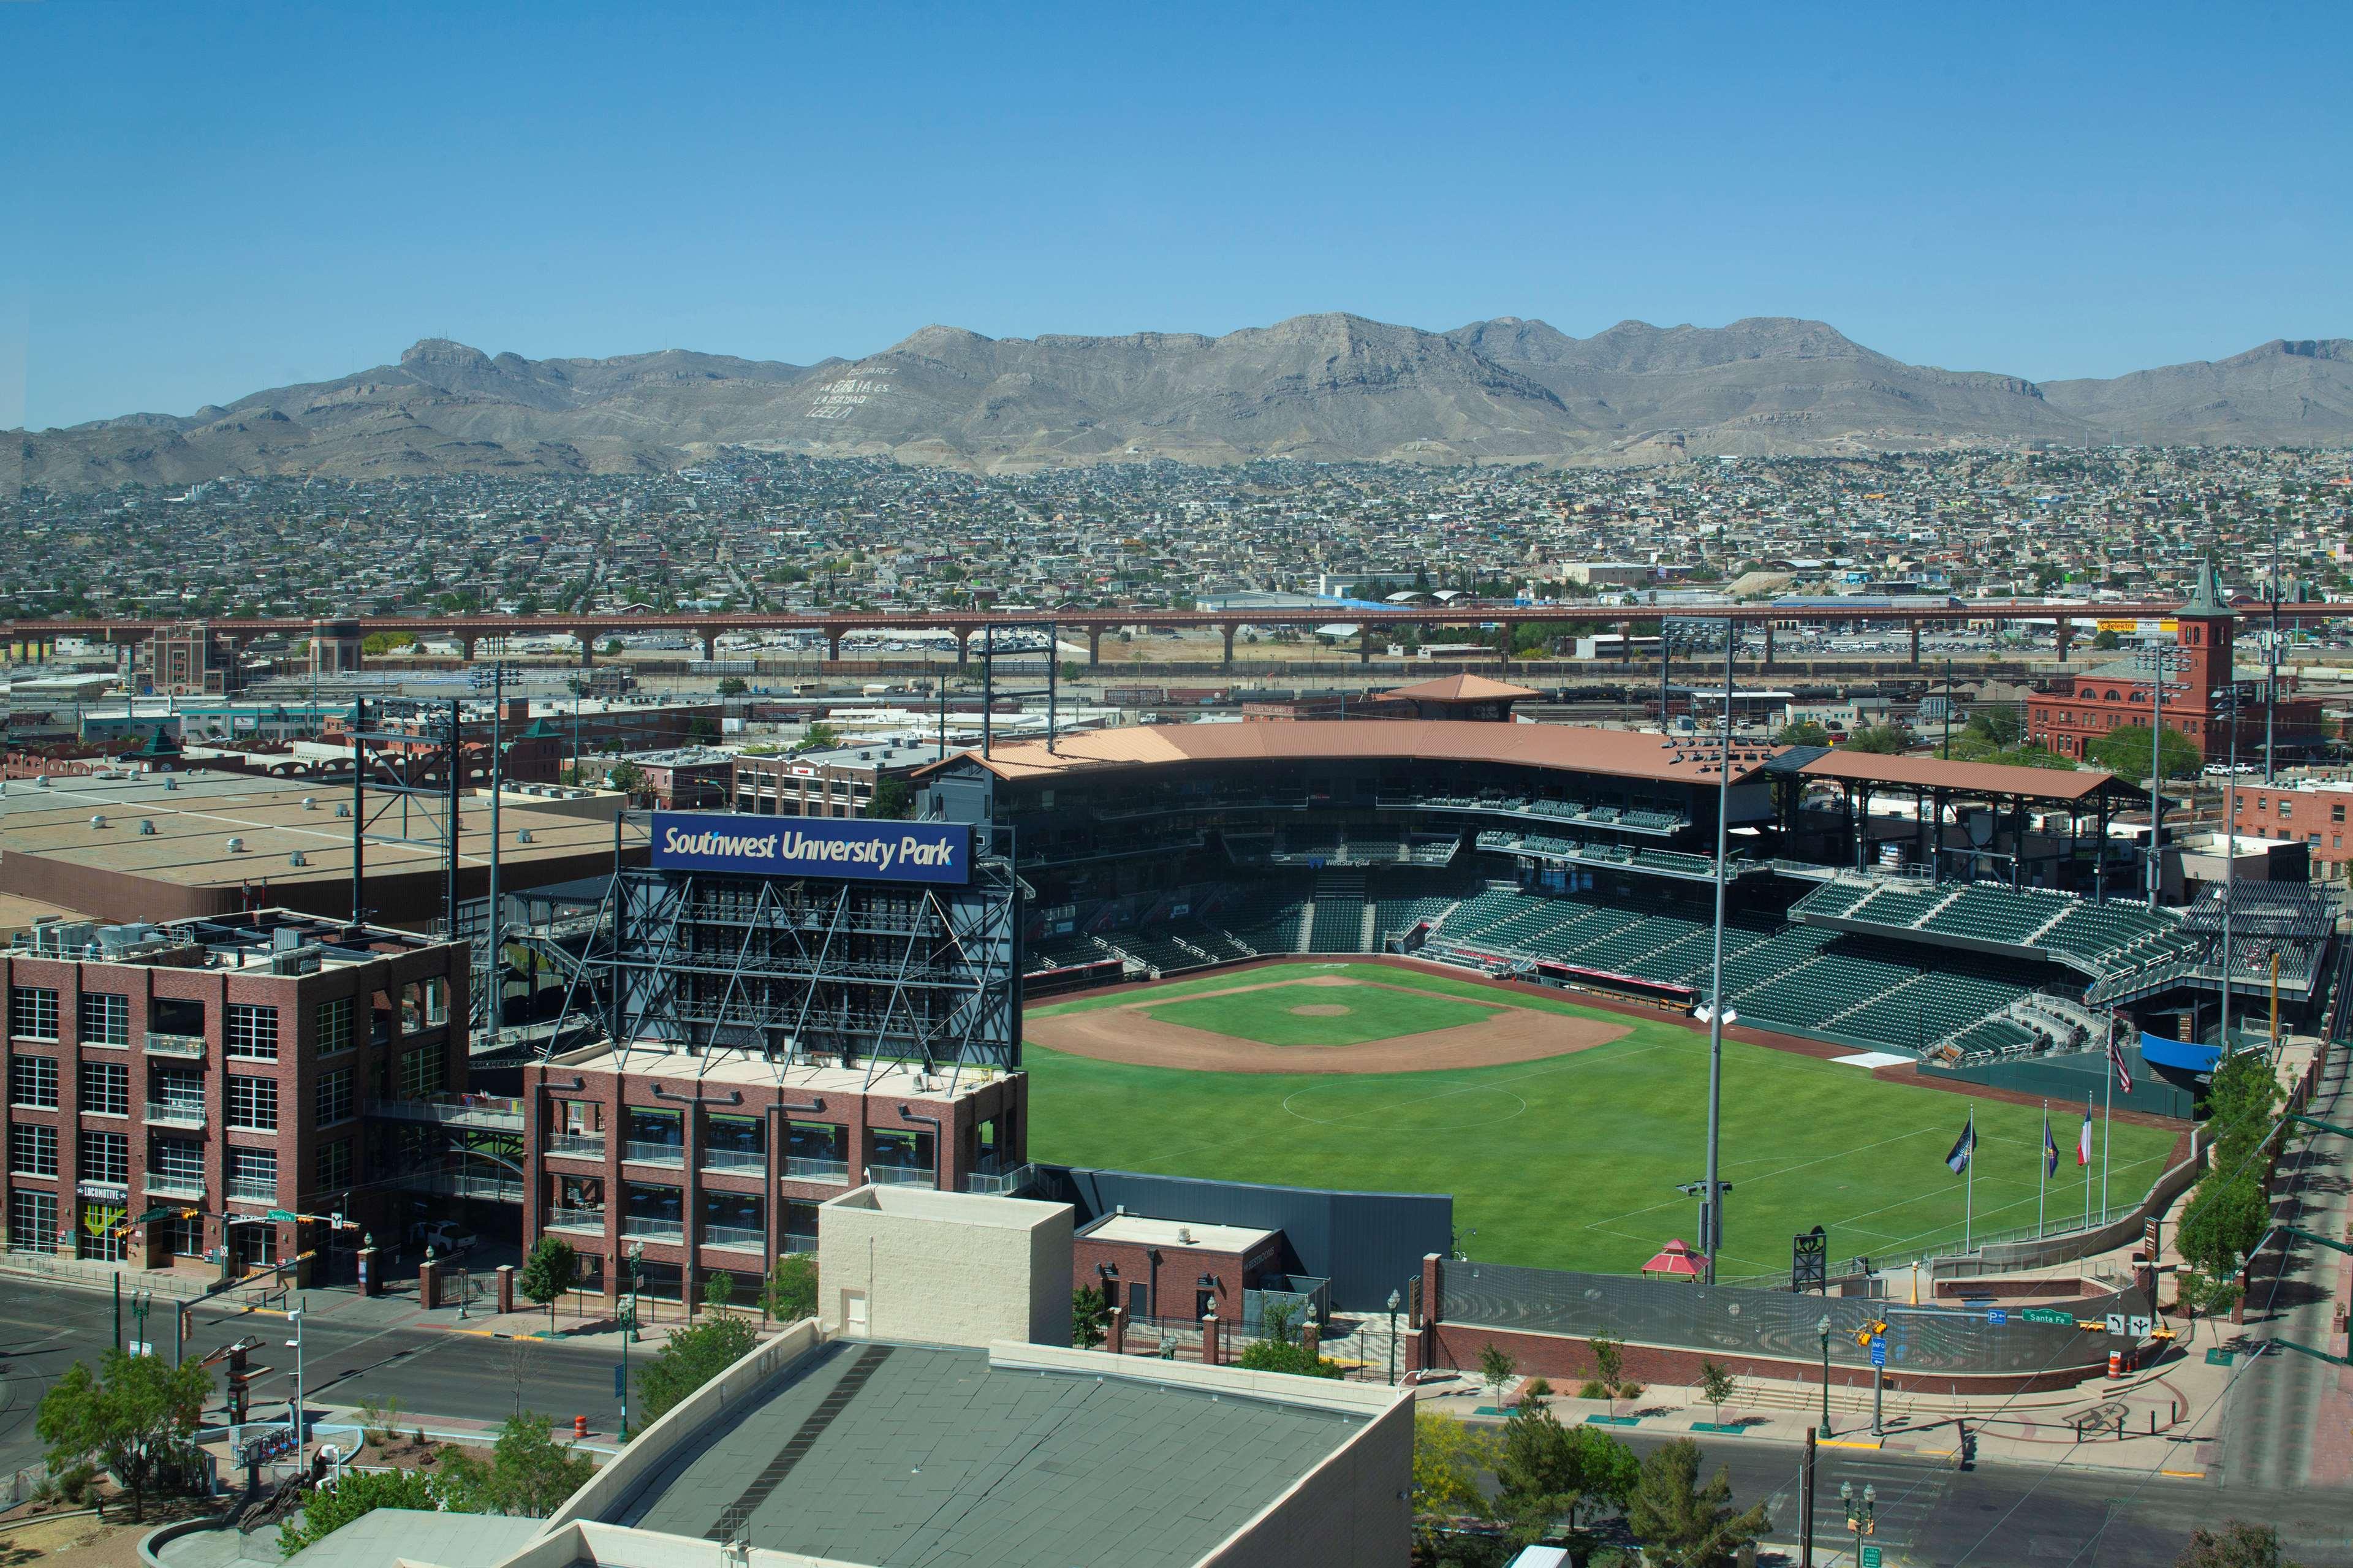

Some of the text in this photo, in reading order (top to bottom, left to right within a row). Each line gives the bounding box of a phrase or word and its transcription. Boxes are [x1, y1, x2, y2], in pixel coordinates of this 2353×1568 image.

[664, 827, 954, 872] Southwest University Park
[1354, 858, 1370, 867] Club
[85, 1186, 119, 1200] LOCOMOTIVE
[2030, 1314, 2053, 1322] Santa
